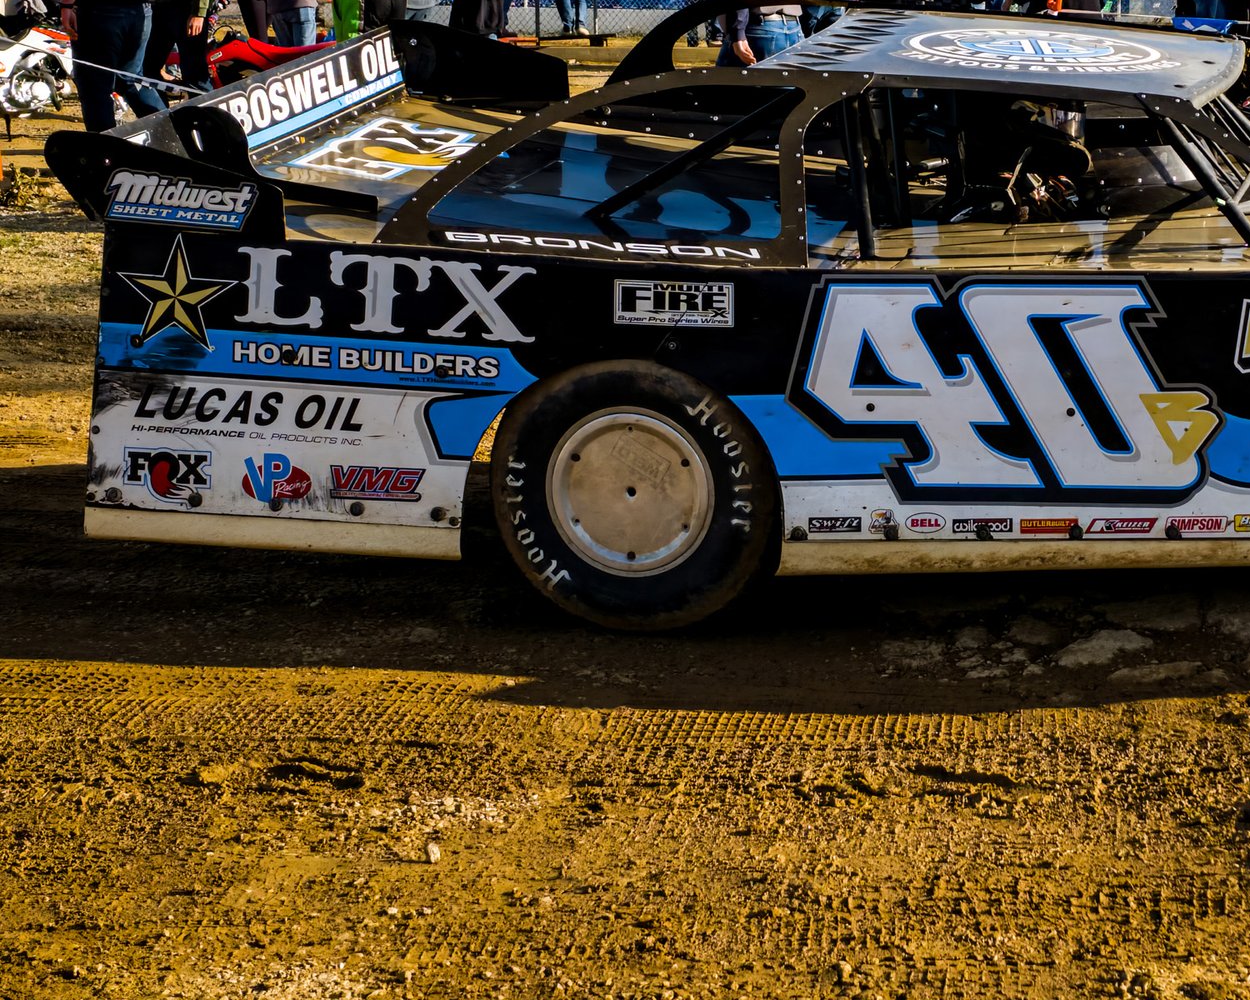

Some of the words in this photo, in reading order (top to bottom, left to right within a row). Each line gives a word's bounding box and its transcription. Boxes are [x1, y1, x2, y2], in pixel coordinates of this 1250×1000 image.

[902, 51, 1022, 70] TATTOOS
[1057, 60, 1183, 73] PIERCINGS
[229, 54, 358, 137] BOSWELL
[361, 36, 400, 82] OIL
[110, 171, 253, 214] Midwest
[112, 204, 172, 218] SHEET
[175, 210, 239, 224] METAL
[444, 231, 761, 259] BRONSON
[233, 246, 537, 344] LTX
[620, 285, 727, 313] FIRE
[617, 314, 647, 323] Super
[667, 316, 699, 324] Series
[700, 317, 729, 325] Wires
[133, 386, 287, 427] LUCAS
[294, 394, 364, 432] OIL
[131, 424, 246, 439] HI-PERFORMANCE
[249, 431, 267, 440] OIL
[270, 432, 338, 445] PRODUCTS
[340, 437, 364, 447] INC.
[126, 450, 210, 490] FOX
[243, 452, 292, 503] VP
[273, 480, 312, 497] Racing
[331, 466, 423, 493] VMG
[910, 517, 941, 528] BELL
[1170, 518, 1222, 530] SIMPSON
